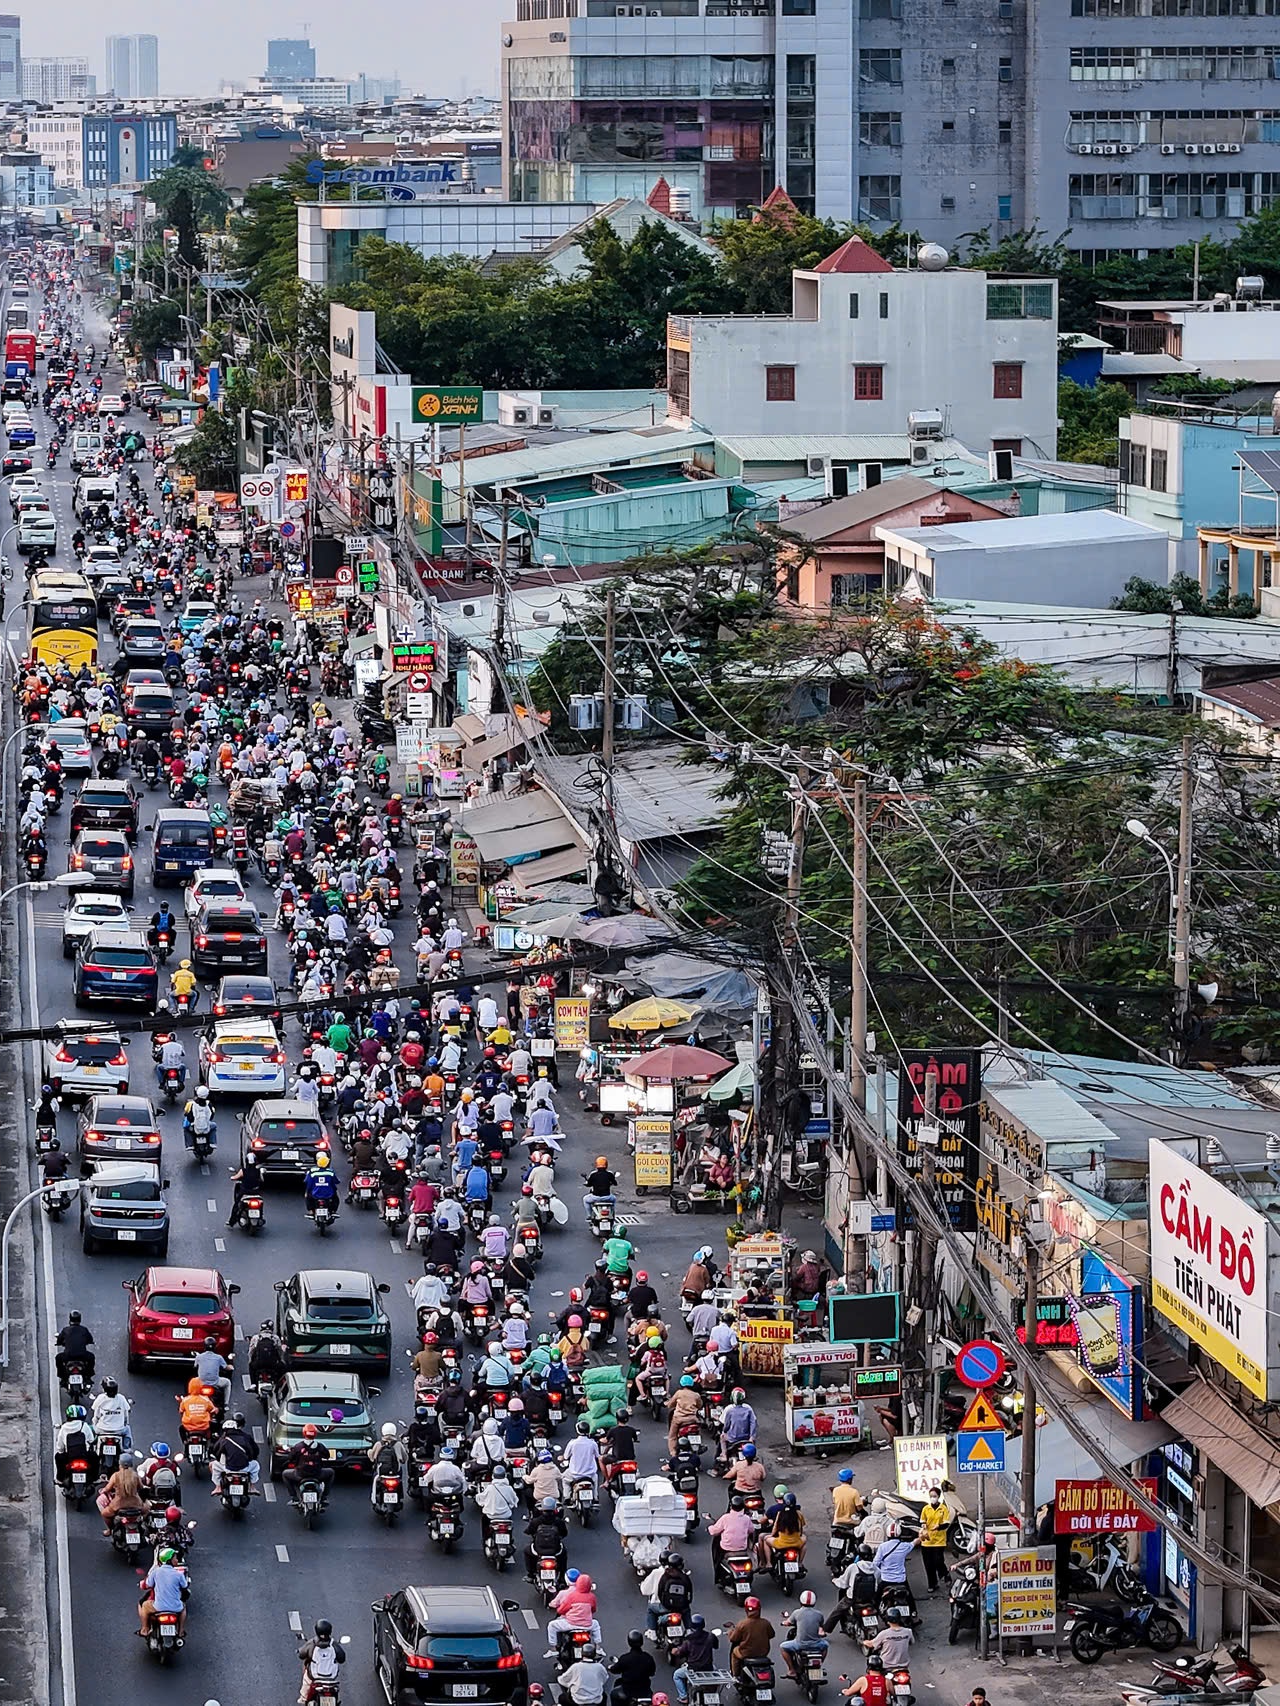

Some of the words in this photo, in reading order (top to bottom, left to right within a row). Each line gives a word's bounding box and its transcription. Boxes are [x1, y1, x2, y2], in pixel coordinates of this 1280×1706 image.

[306, 160, 456, 183] Sacombank
[443, 395, 462, 404] Bách
[464, 395, 478, 403] hóa
[441, 405, 478, 414] XANH
[946, 1117, 966, 1133] MÁY
[942, 1134, 963, 1151] ĐẤT
[1160, 1178, 1212, 1265] CẦM
[1219, 1226, 1255, 1296] ĐỒ
[1174, 1256, 1203, 1309] TIẾN
[1207, 1288, 1242, 1340] PHÁT
[815, 1353, 832, 1362] DÂU
[834, 1352, 855, 1360] TƯƠI
[910, 1440, 931, 1451] BÁNH
[899, 1453, 944, 1472] TUẤN
[960, 1461, 1003, 1471] CHỢ-MARKET
[906, 1475, 940, 1494] MẬP
[1071, 1514, 1091, 1529] DỜI
[1095, 1513, 1110, 1529] VỀ
[1114, 1514, 1139, 1529] ĐÂY
[1002, 1577, 1033, 1589] CHUYỂN
[1035, 1577, 1052, 1588] TIỀN
